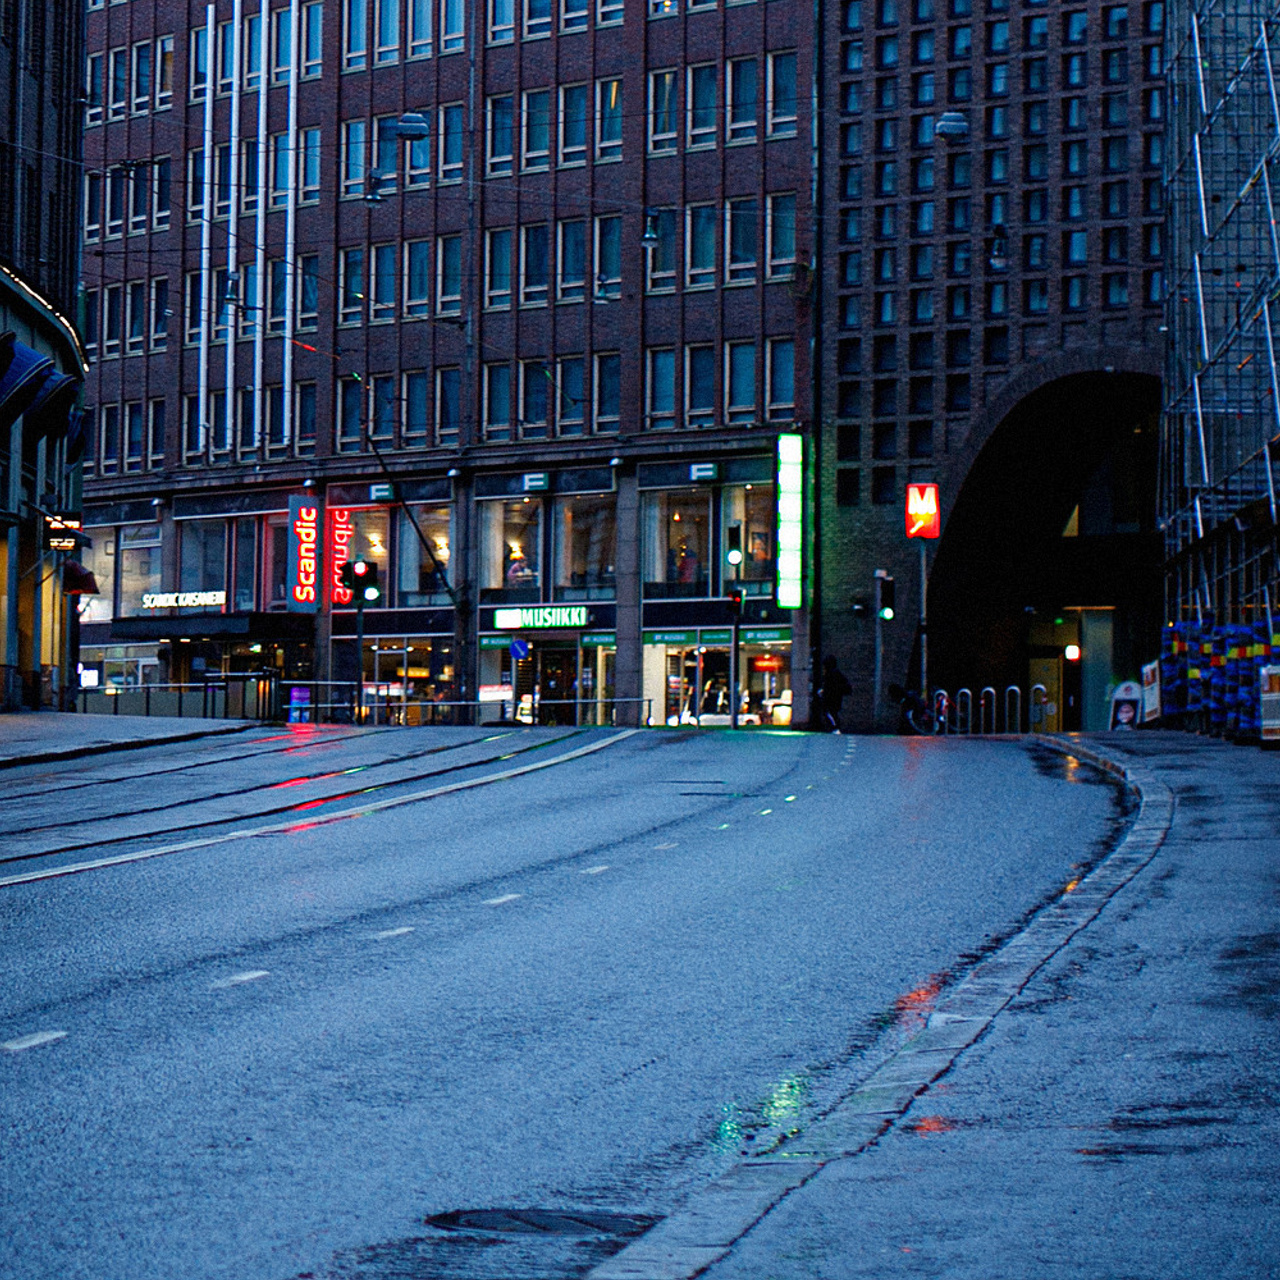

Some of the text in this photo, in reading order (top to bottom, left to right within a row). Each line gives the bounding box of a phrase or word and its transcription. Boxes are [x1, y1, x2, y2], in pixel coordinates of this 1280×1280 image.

[908, 486, 937, 515] M
[293, 506, 318, 604] Scandic
[522, 607, 586, 627] MUSIIKKI
